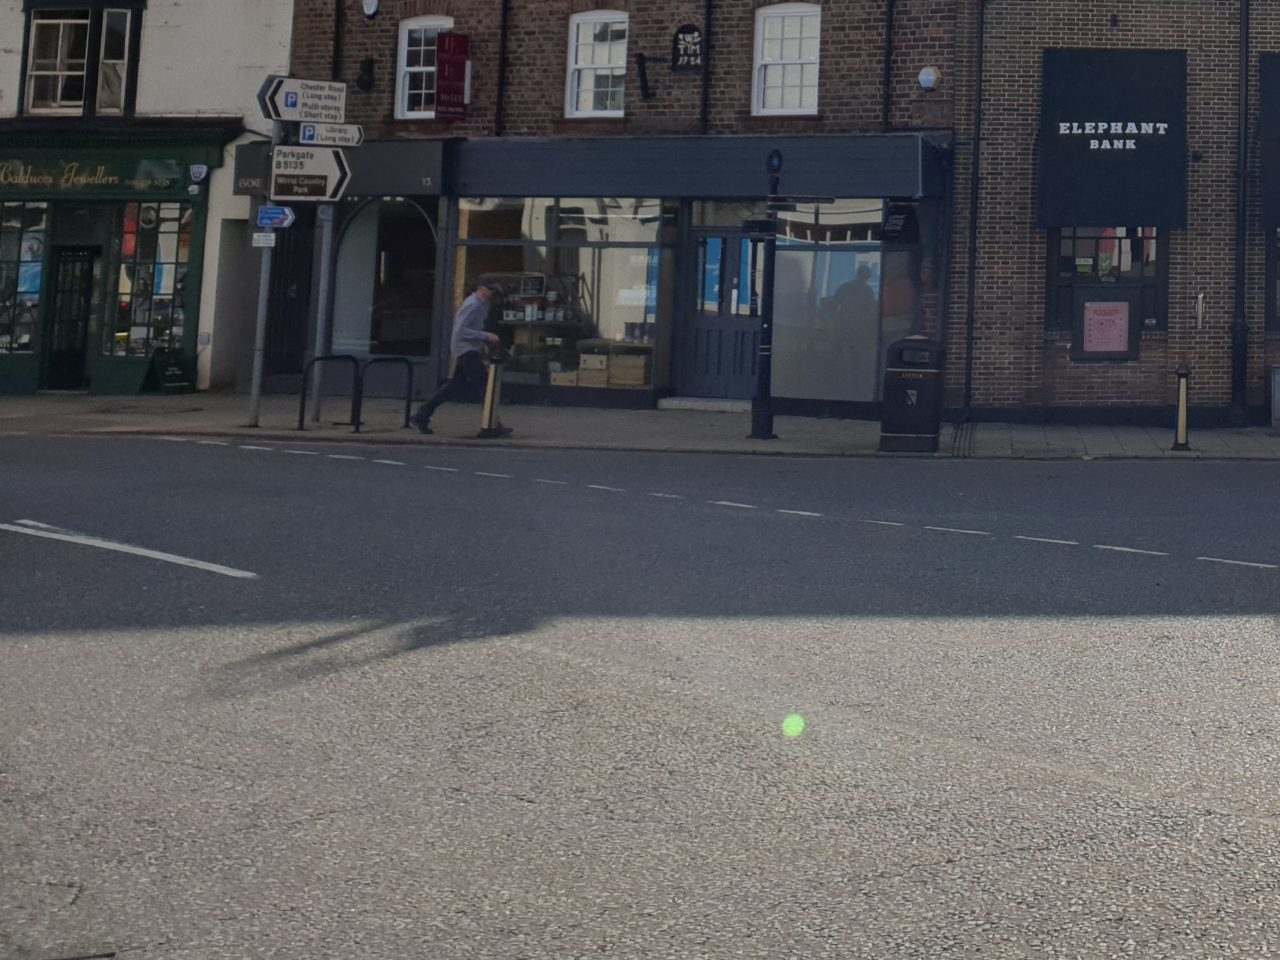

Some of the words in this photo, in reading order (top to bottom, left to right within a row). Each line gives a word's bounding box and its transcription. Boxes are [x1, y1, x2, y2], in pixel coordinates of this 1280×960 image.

[300, 82, 326, 91] Chester
[328, 84, 345, 93] Road
[325, 126, 348, 136] Library
[1059, 122, 1168, 135] ELEPHANT
[1090, 139, 1137, 149] BANK
[276, 149, 315, 161] Parkgate
[59, 160, 120, 187] Jewellers
[276, 176, 297, 184] Wirral
[299, 176, 326, 187] Country
[293, 185, 308, 193] Park
